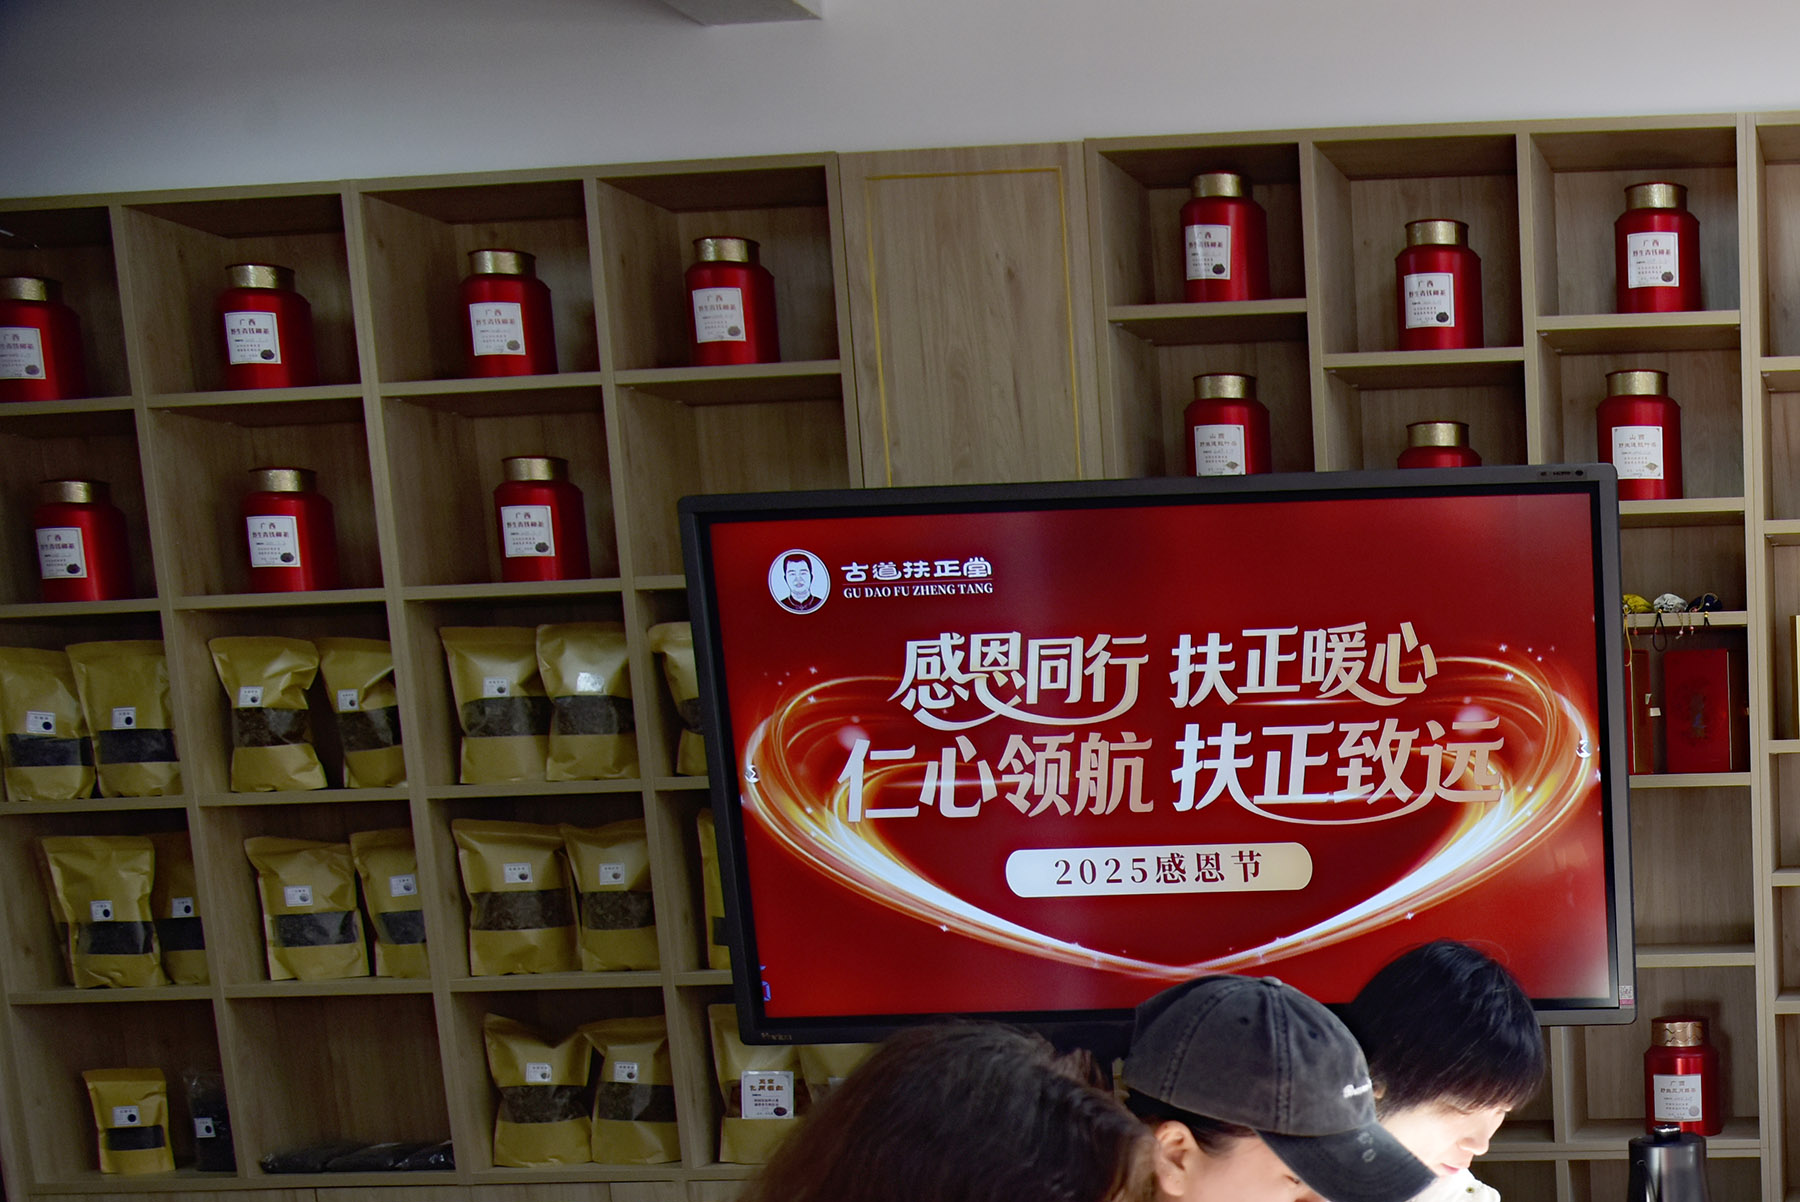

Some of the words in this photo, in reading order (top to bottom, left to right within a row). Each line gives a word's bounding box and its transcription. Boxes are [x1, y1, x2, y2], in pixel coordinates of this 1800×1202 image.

[841, 557, 992, 582] 古道扶正堂
[843, 587, 861, 599] GU
[864, 586, 891, 598] DAO
[894, 585, 910, 597] FU
[912, 584, 956, 596] ZHENG
[957, 582, 993, 594] TANG
[887, 631, 1149, 731] 感恩同行
[1169, 621, 1438, 708] 扶正暖心
[838, 732, 1154, 822] 仁心领航
[1171, 717, 1504, 825] 扶正致远
[1054, 850, 1262, 885] 2025感恩节
